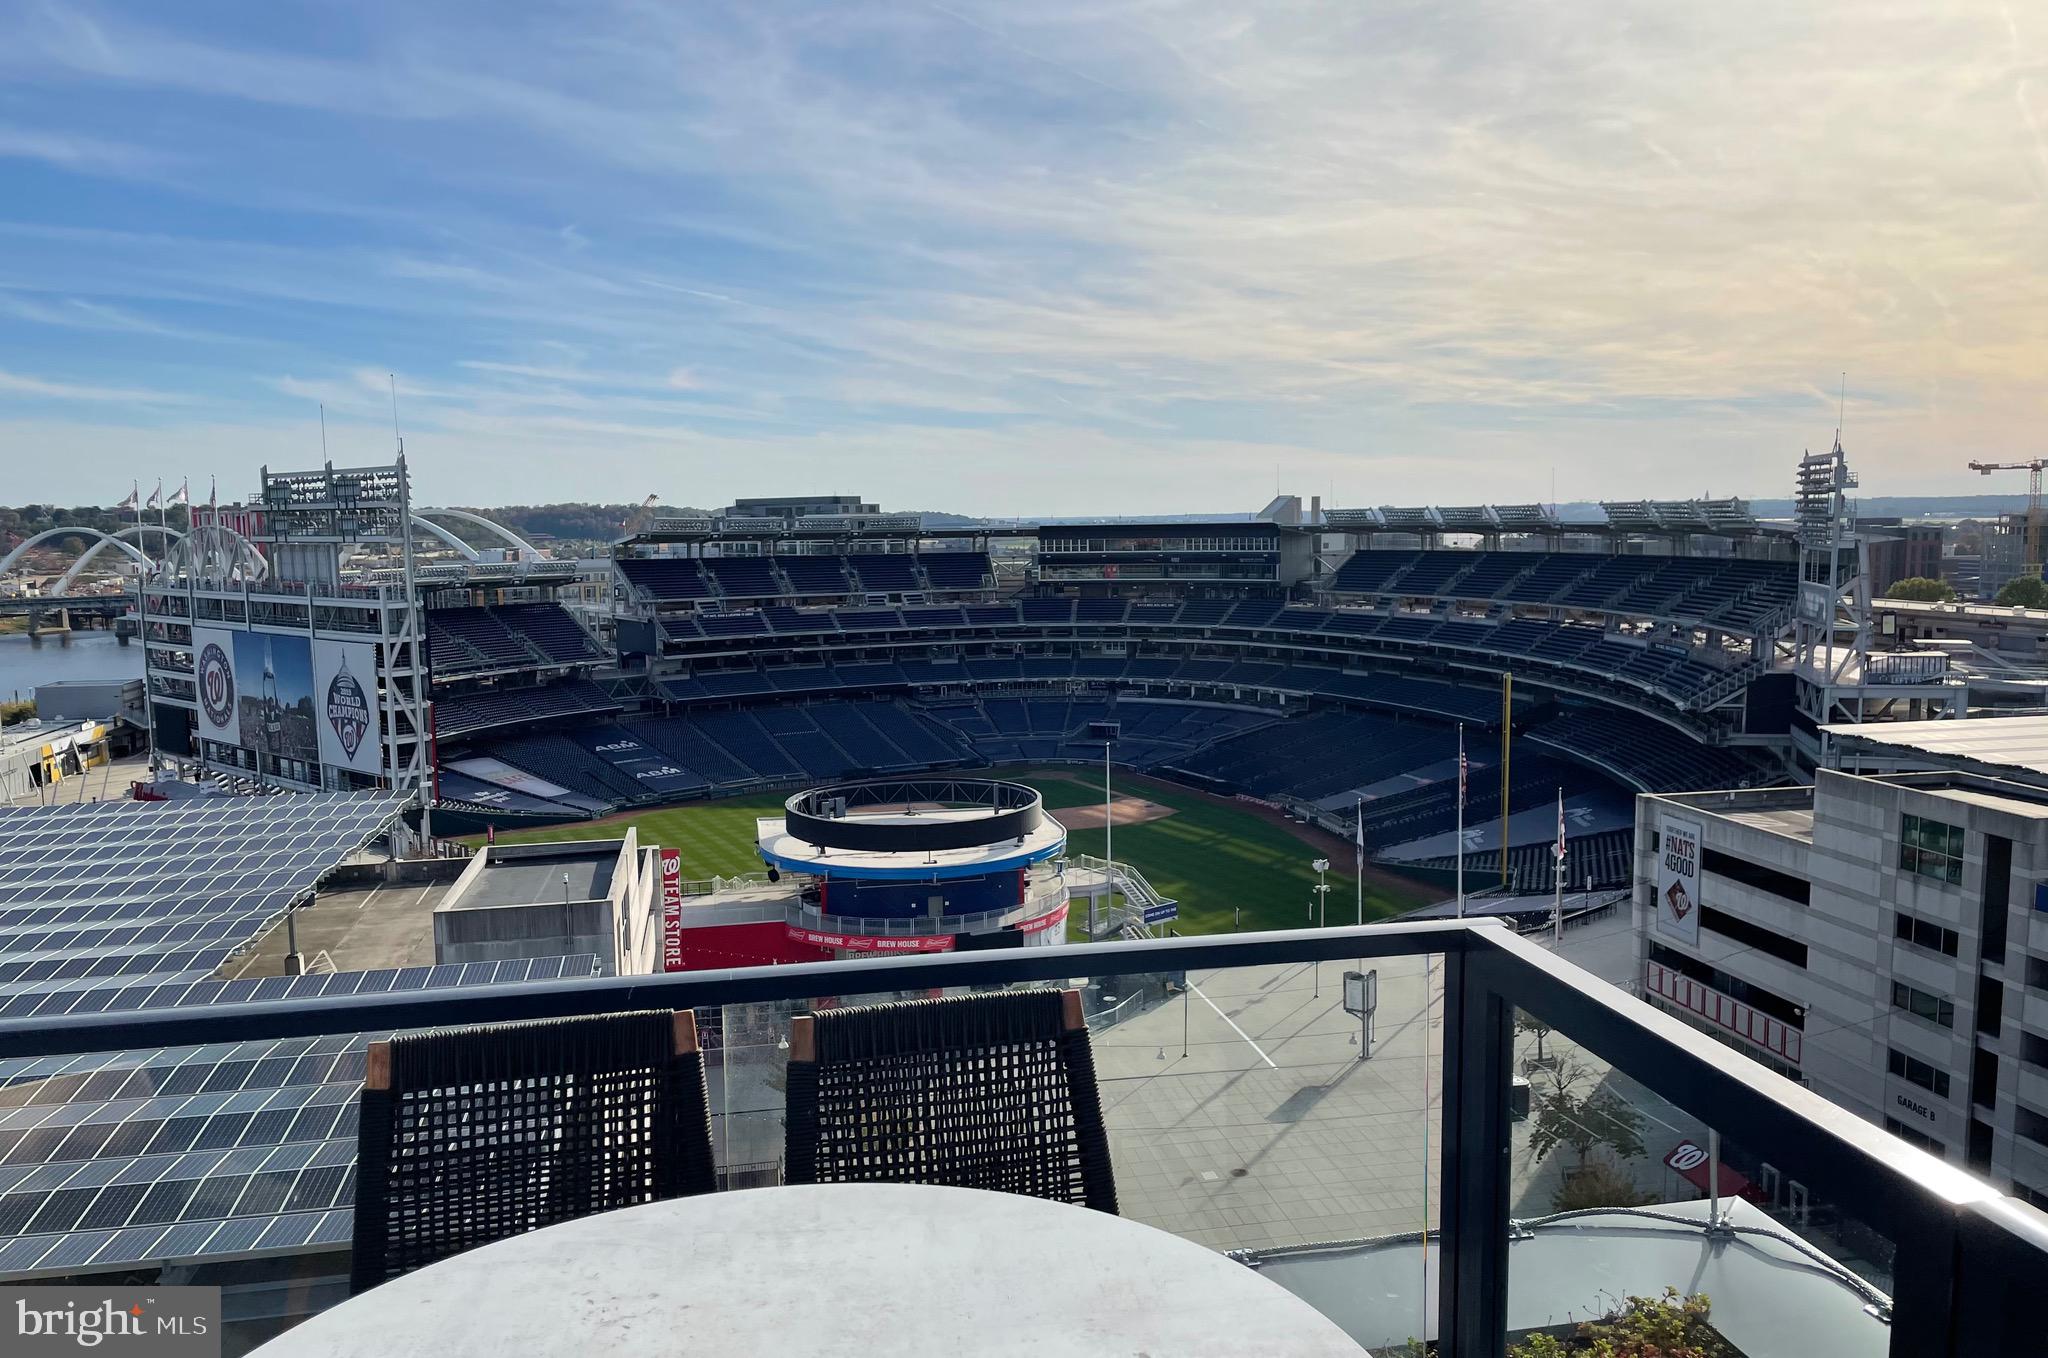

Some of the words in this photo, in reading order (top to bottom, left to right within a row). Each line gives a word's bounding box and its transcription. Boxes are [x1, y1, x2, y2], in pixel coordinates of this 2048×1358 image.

[333, 691, 361, 707] WORLD
[328, 704, 368, 725] CHAMPIONS
[636, 766, 681, 778] ABM
[1665, 834, 1695, 859] #NATS
[1664, 853, 1694, 878] 4GOOD
[664, 877, 680, 916] TEAM
[665, 920, 681, 967] STORE
[808, 933, 823, 943] BREW
[823, 936, 843, 946] HOUSE
[877, 940, 896, 948] BREW
[897, 940, 920, 948] HOUSE
[1897, 1095, 1928, 1118] GARAGE
